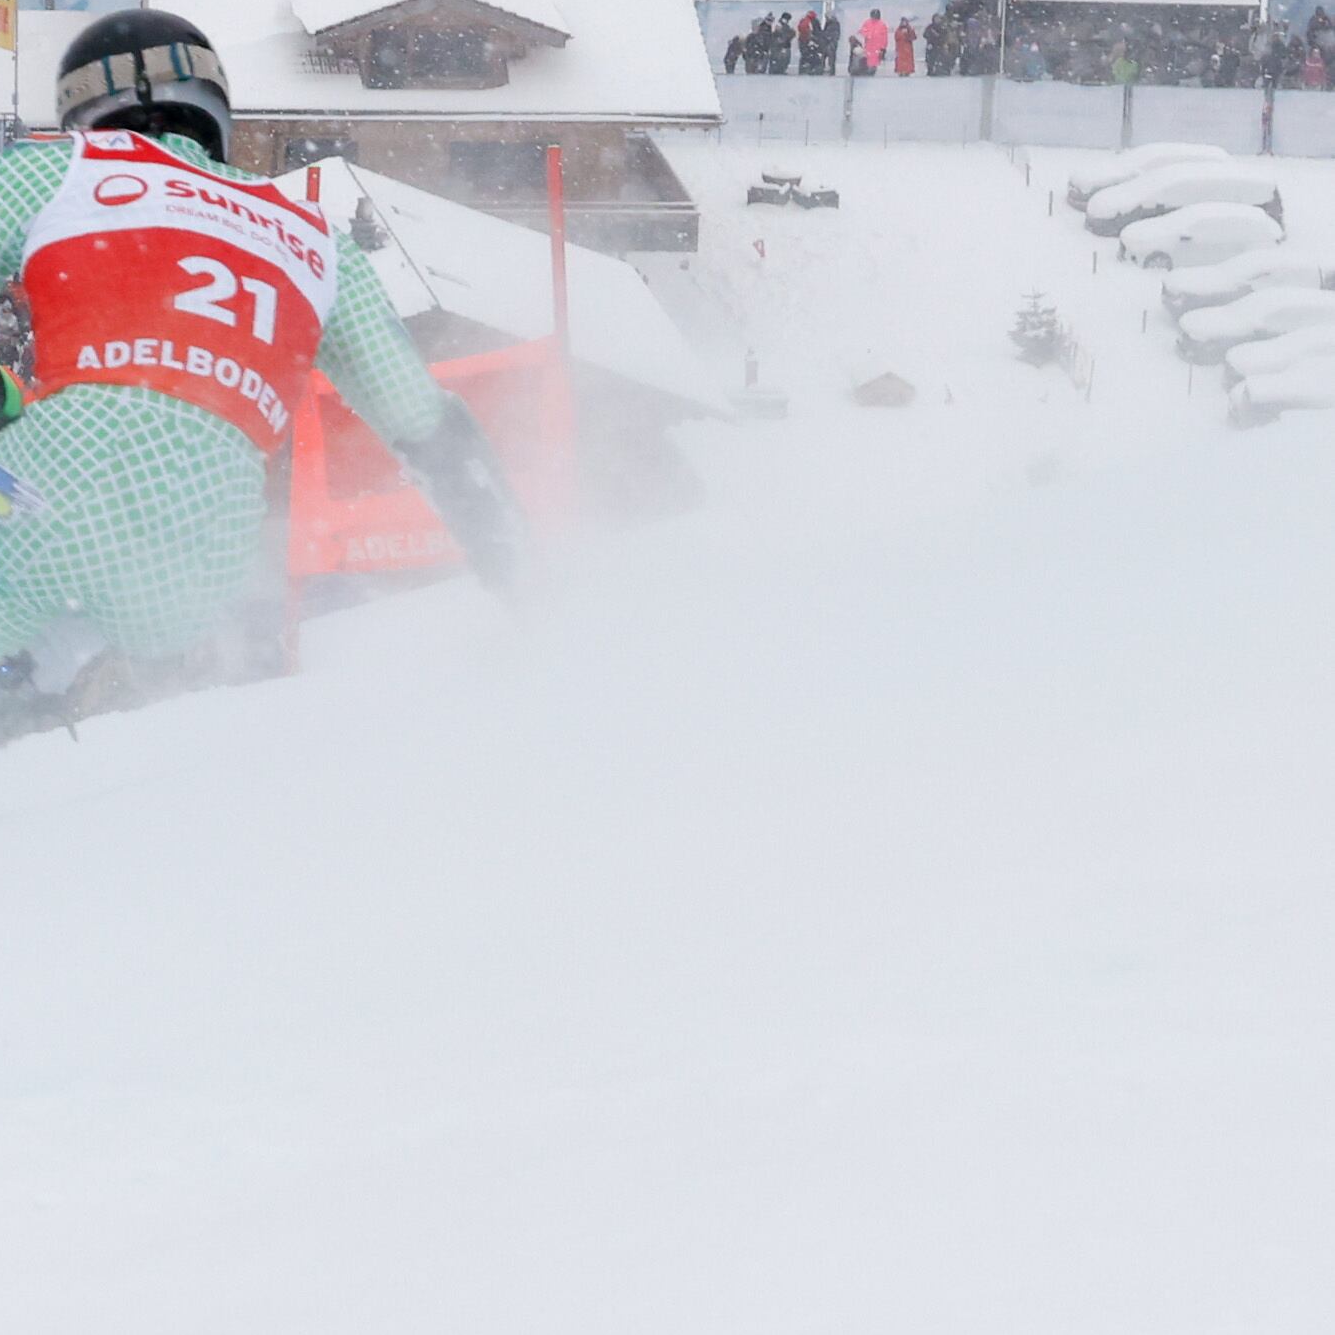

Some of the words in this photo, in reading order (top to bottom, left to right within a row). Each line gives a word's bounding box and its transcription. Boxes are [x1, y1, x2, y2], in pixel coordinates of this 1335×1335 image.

[164, 204, 219, 224] DREAM
[164, 178, 325, 279] Sunrise
[173, 255, 278, 345] 21
[76, 338, 289, 435] ADELBODEN
